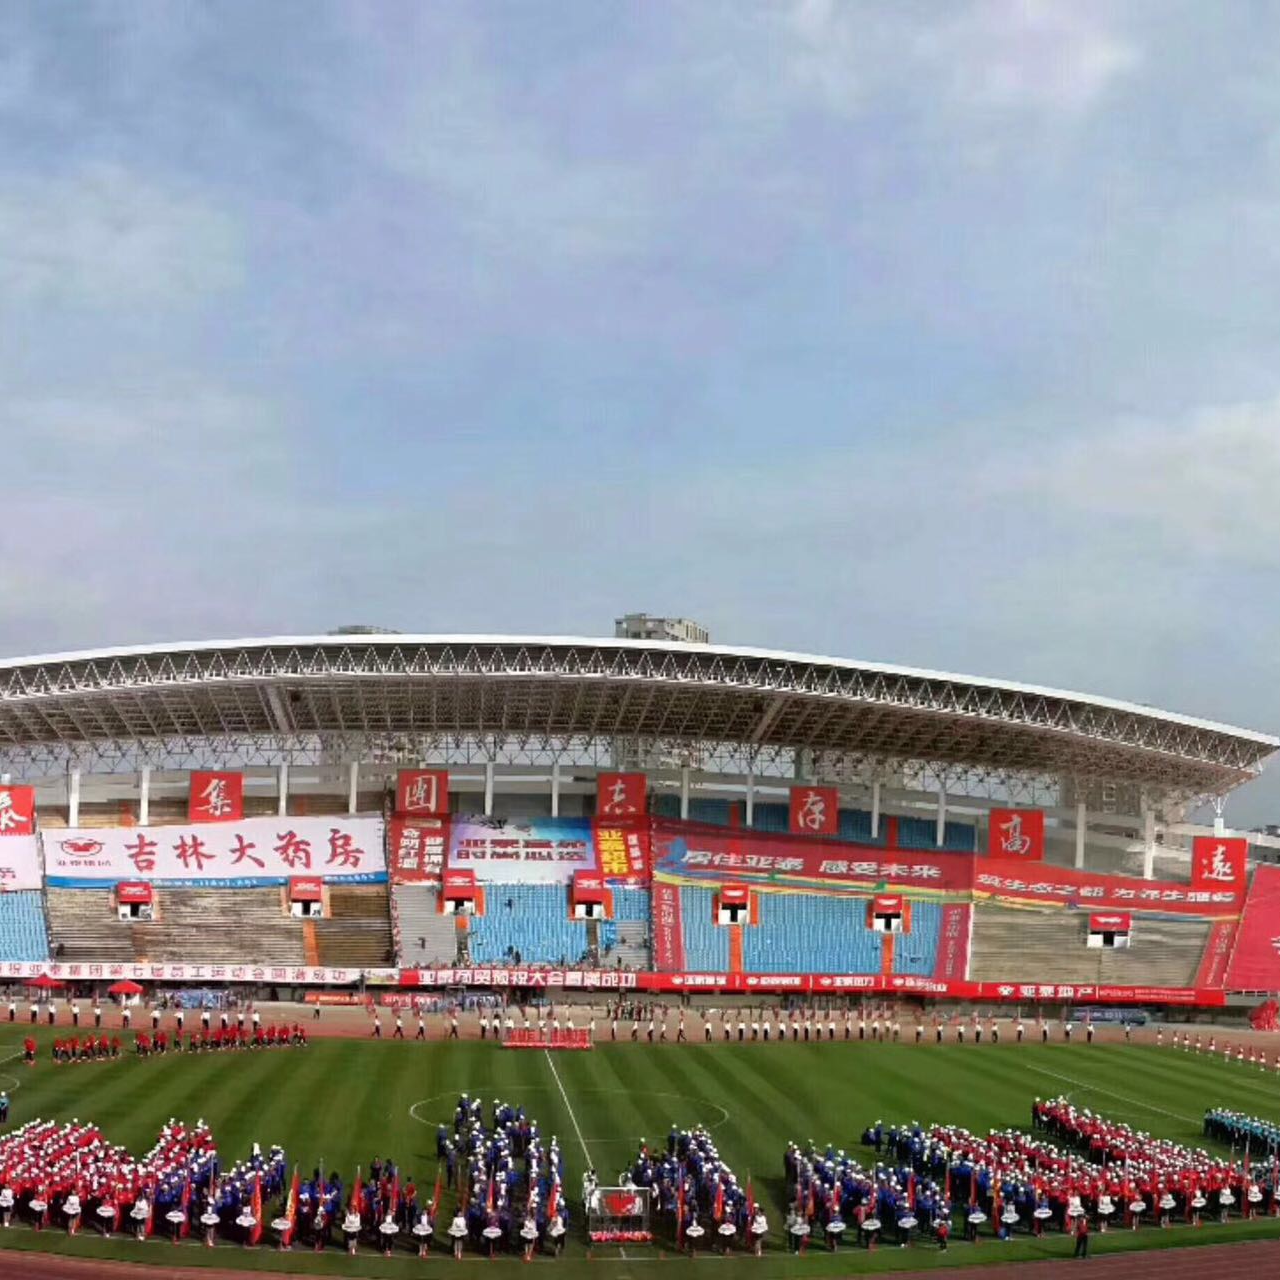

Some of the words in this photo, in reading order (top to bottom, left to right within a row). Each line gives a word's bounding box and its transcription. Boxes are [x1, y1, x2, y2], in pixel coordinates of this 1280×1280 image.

[196, 778, 231, 817] 集
[999, 814, 1030, 855] 高
[123, 828, 366, 872] 吉林大药房
[819, 859, 942, 878] 感受未来
